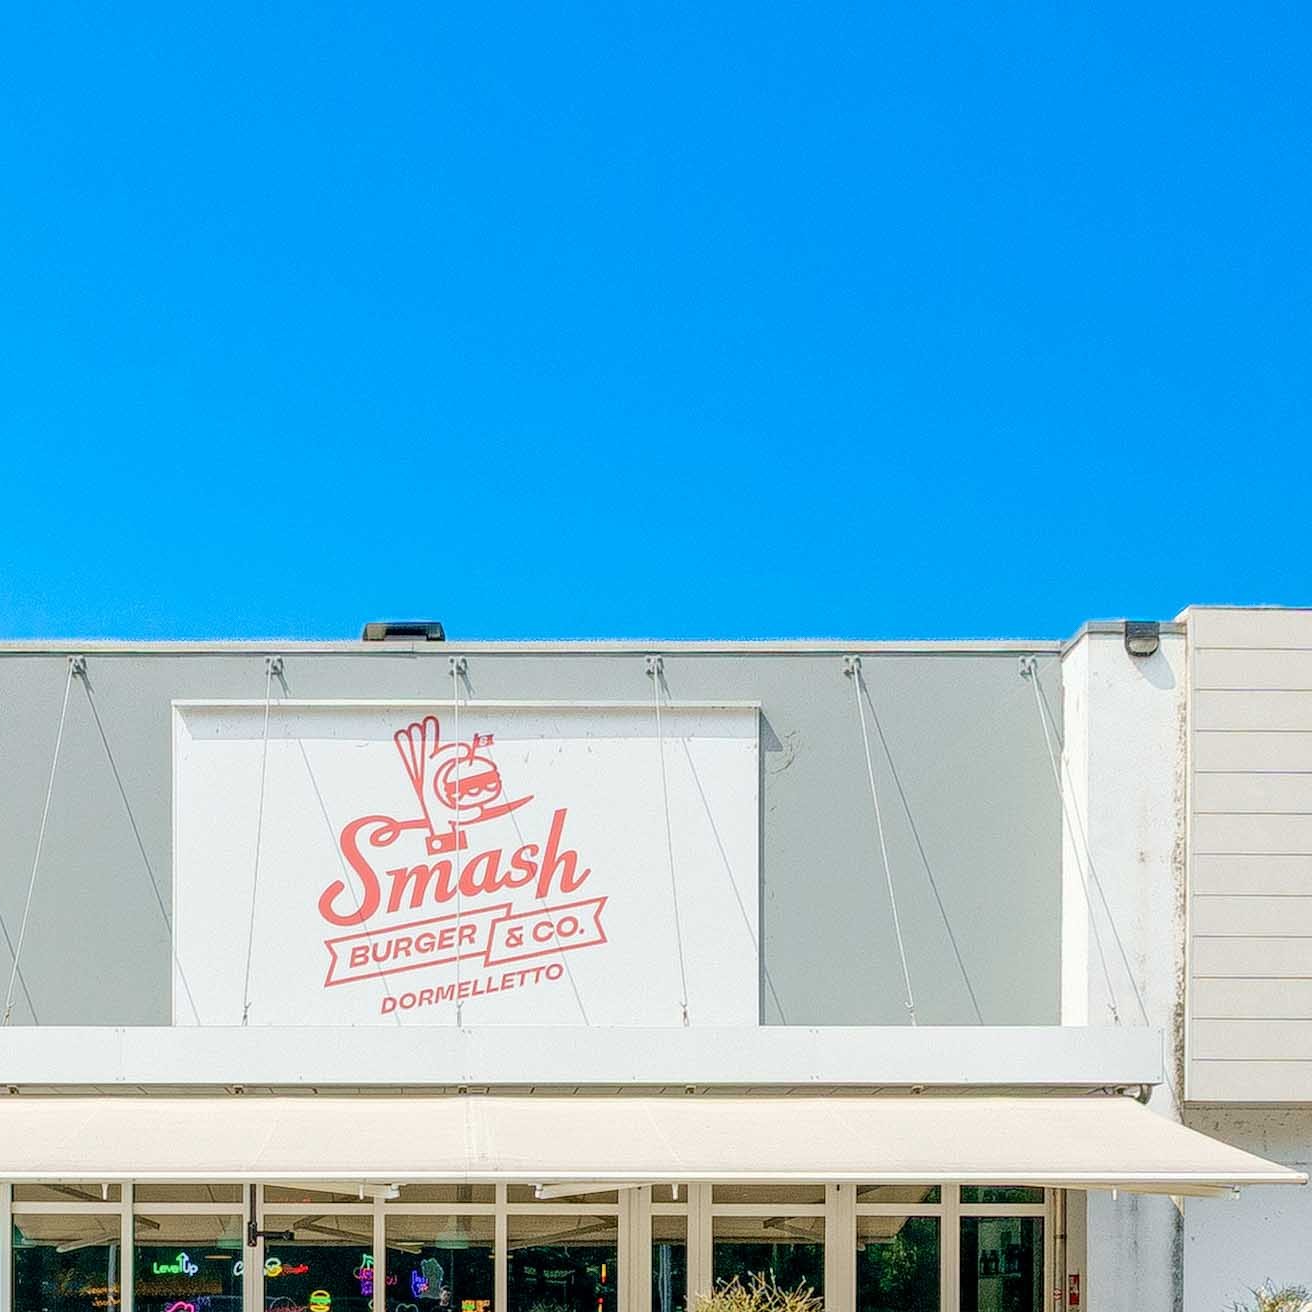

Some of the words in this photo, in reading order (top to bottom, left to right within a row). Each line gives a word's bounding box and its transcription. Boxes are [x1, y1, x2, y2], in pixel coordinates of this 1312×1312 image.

[318, 808, 591, 926] Smash
[349, 923, 478, 968] BURGER
[504, 926, 524, 949] &
[532, 915, 586, 943] CO.
[380, 962, 565, 1014] DORMELLETTO
